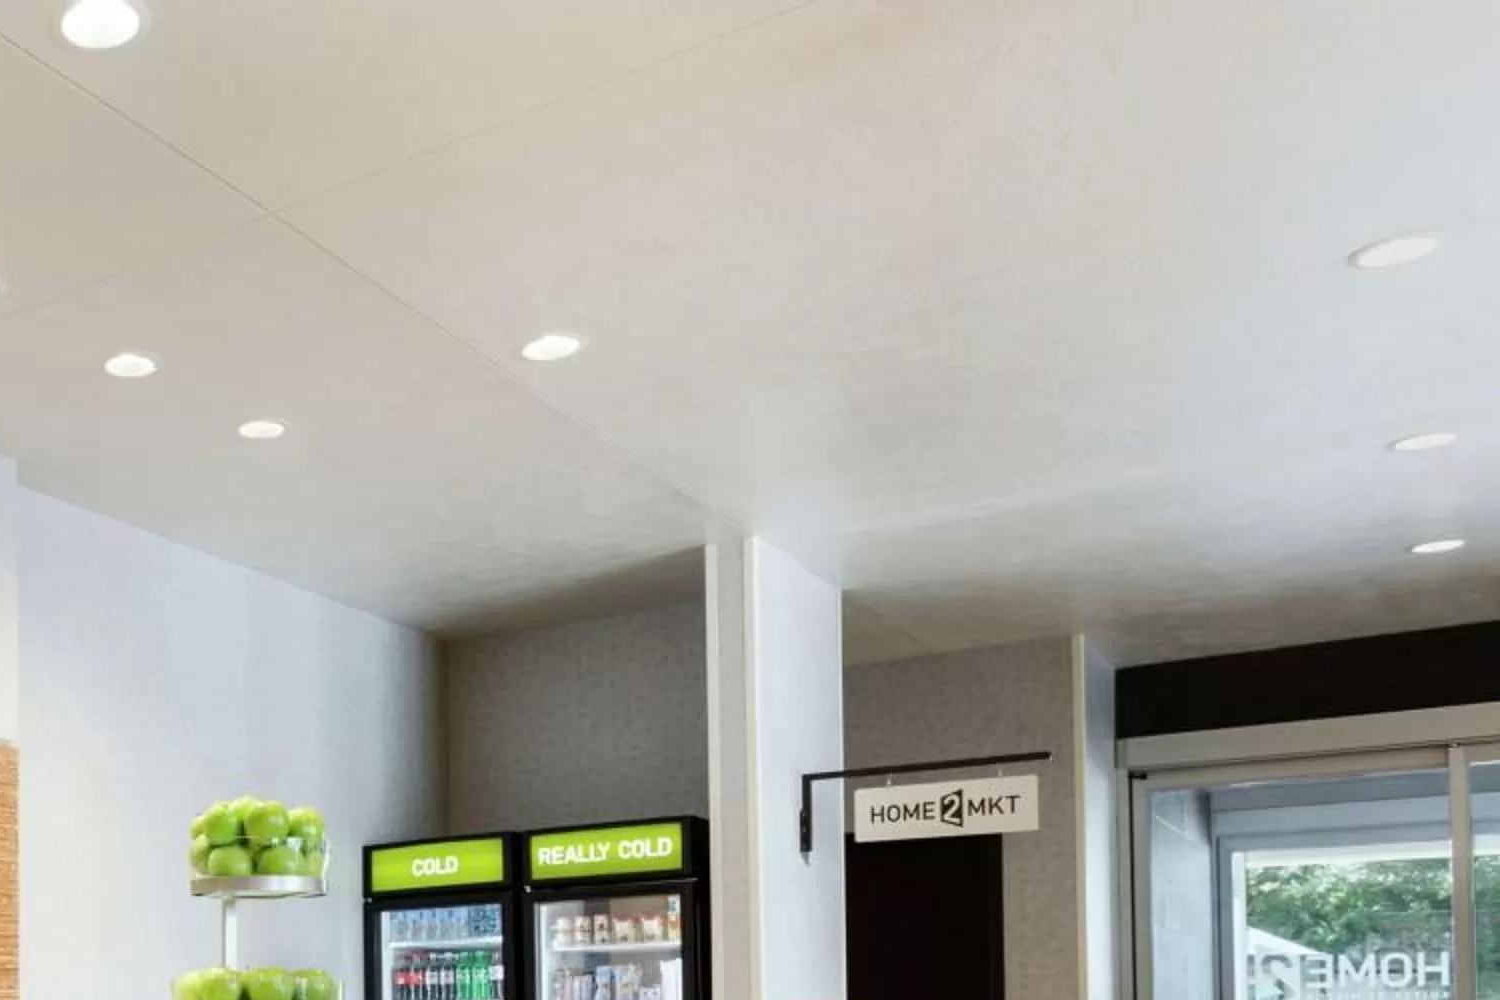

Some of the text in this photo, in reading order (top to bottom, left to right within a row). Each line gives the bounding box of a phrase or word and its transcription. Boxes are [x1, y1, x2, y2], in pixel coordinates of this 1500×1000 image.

[538, 837, 673, 866] REALLY COLD
[411, 856, 459, 877] COLD
